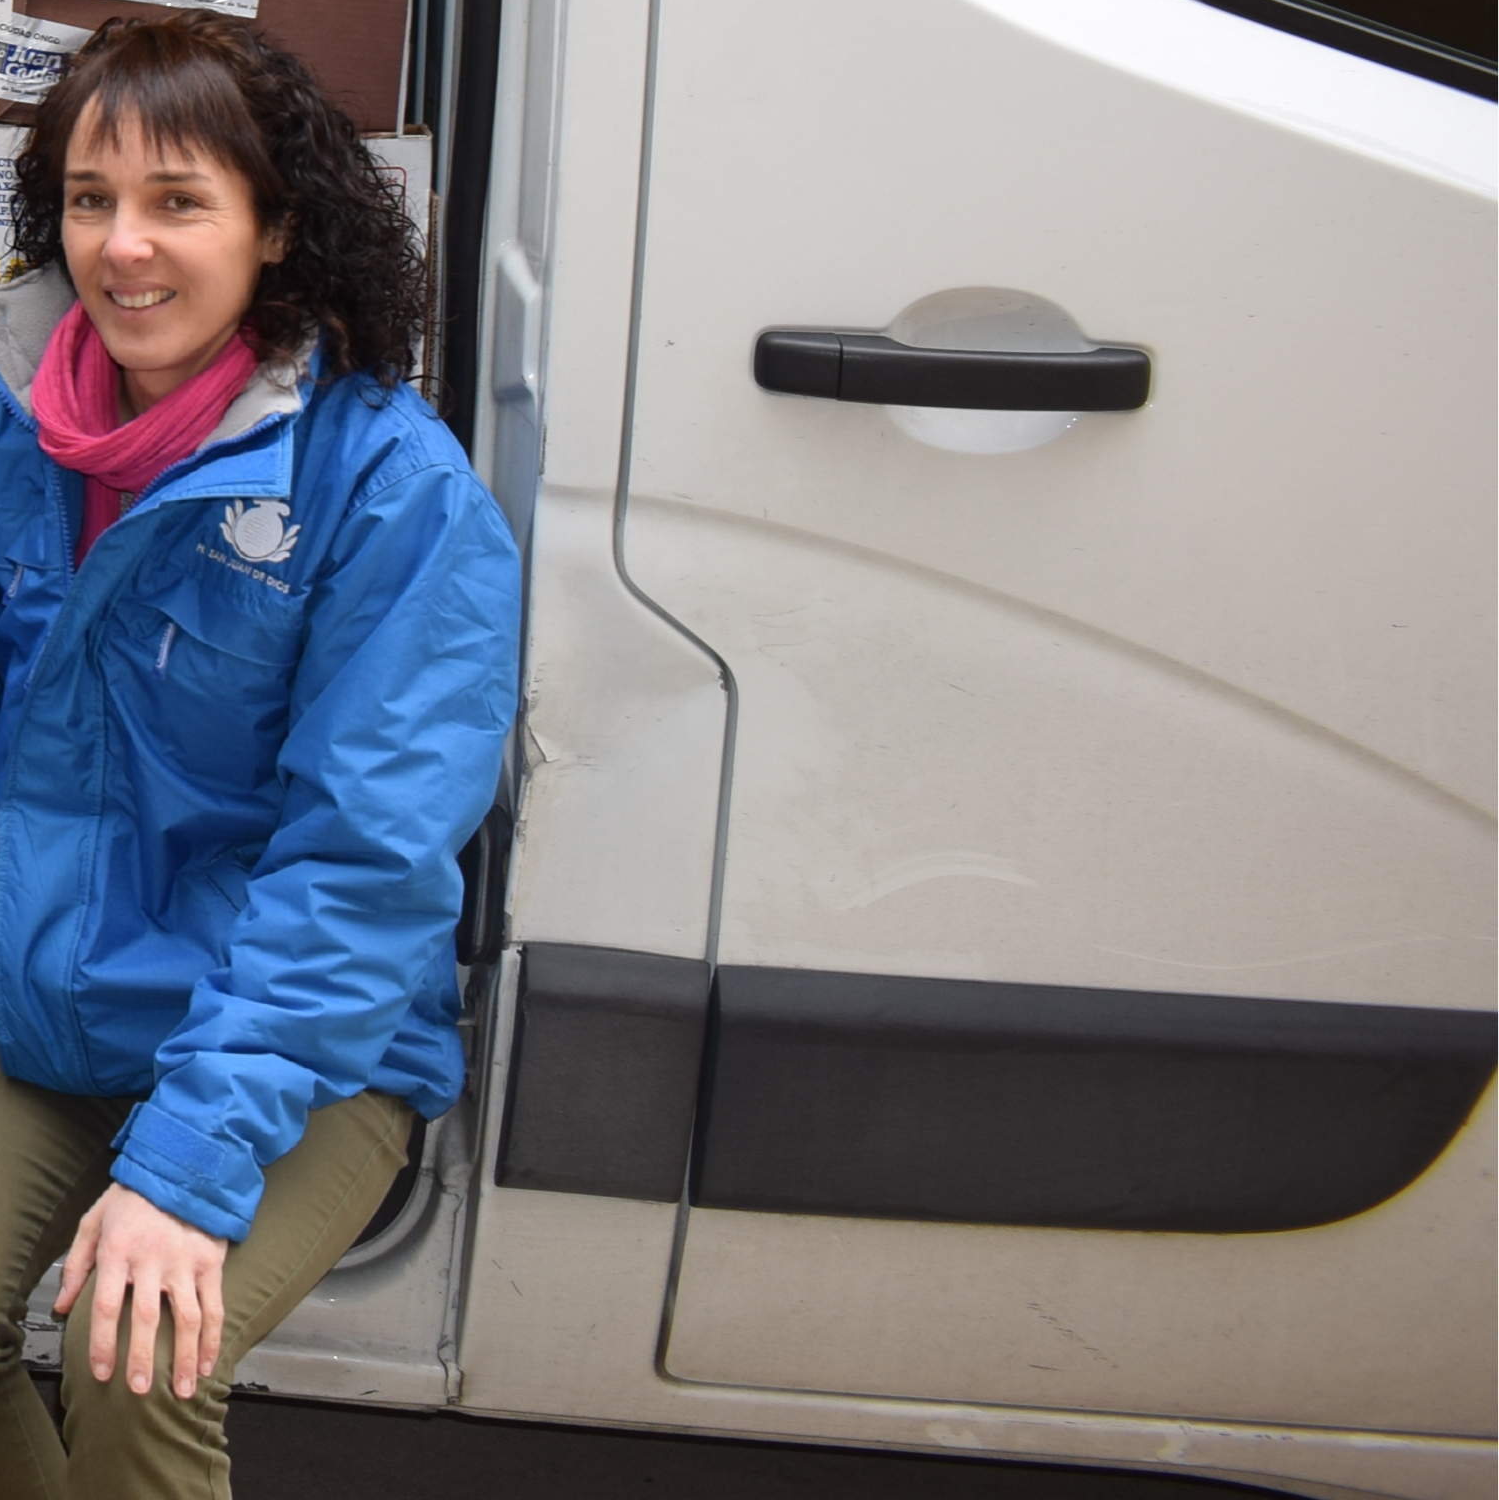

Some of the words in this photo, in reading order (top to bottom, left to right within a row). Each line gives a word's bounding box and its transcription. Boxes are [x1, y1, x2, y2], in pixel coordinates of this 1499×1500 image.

[0, 23, 32, 39] CIUDAD
[33, 33, 61, 44] ONGD
[8, 45, 62, 67] Juan
[209, 549, 227, 563] SAN
[227, 559, 252, 575] JUAN
[253, 570, 265, 581] DE
[267, 576, 290, 593] DIOS
